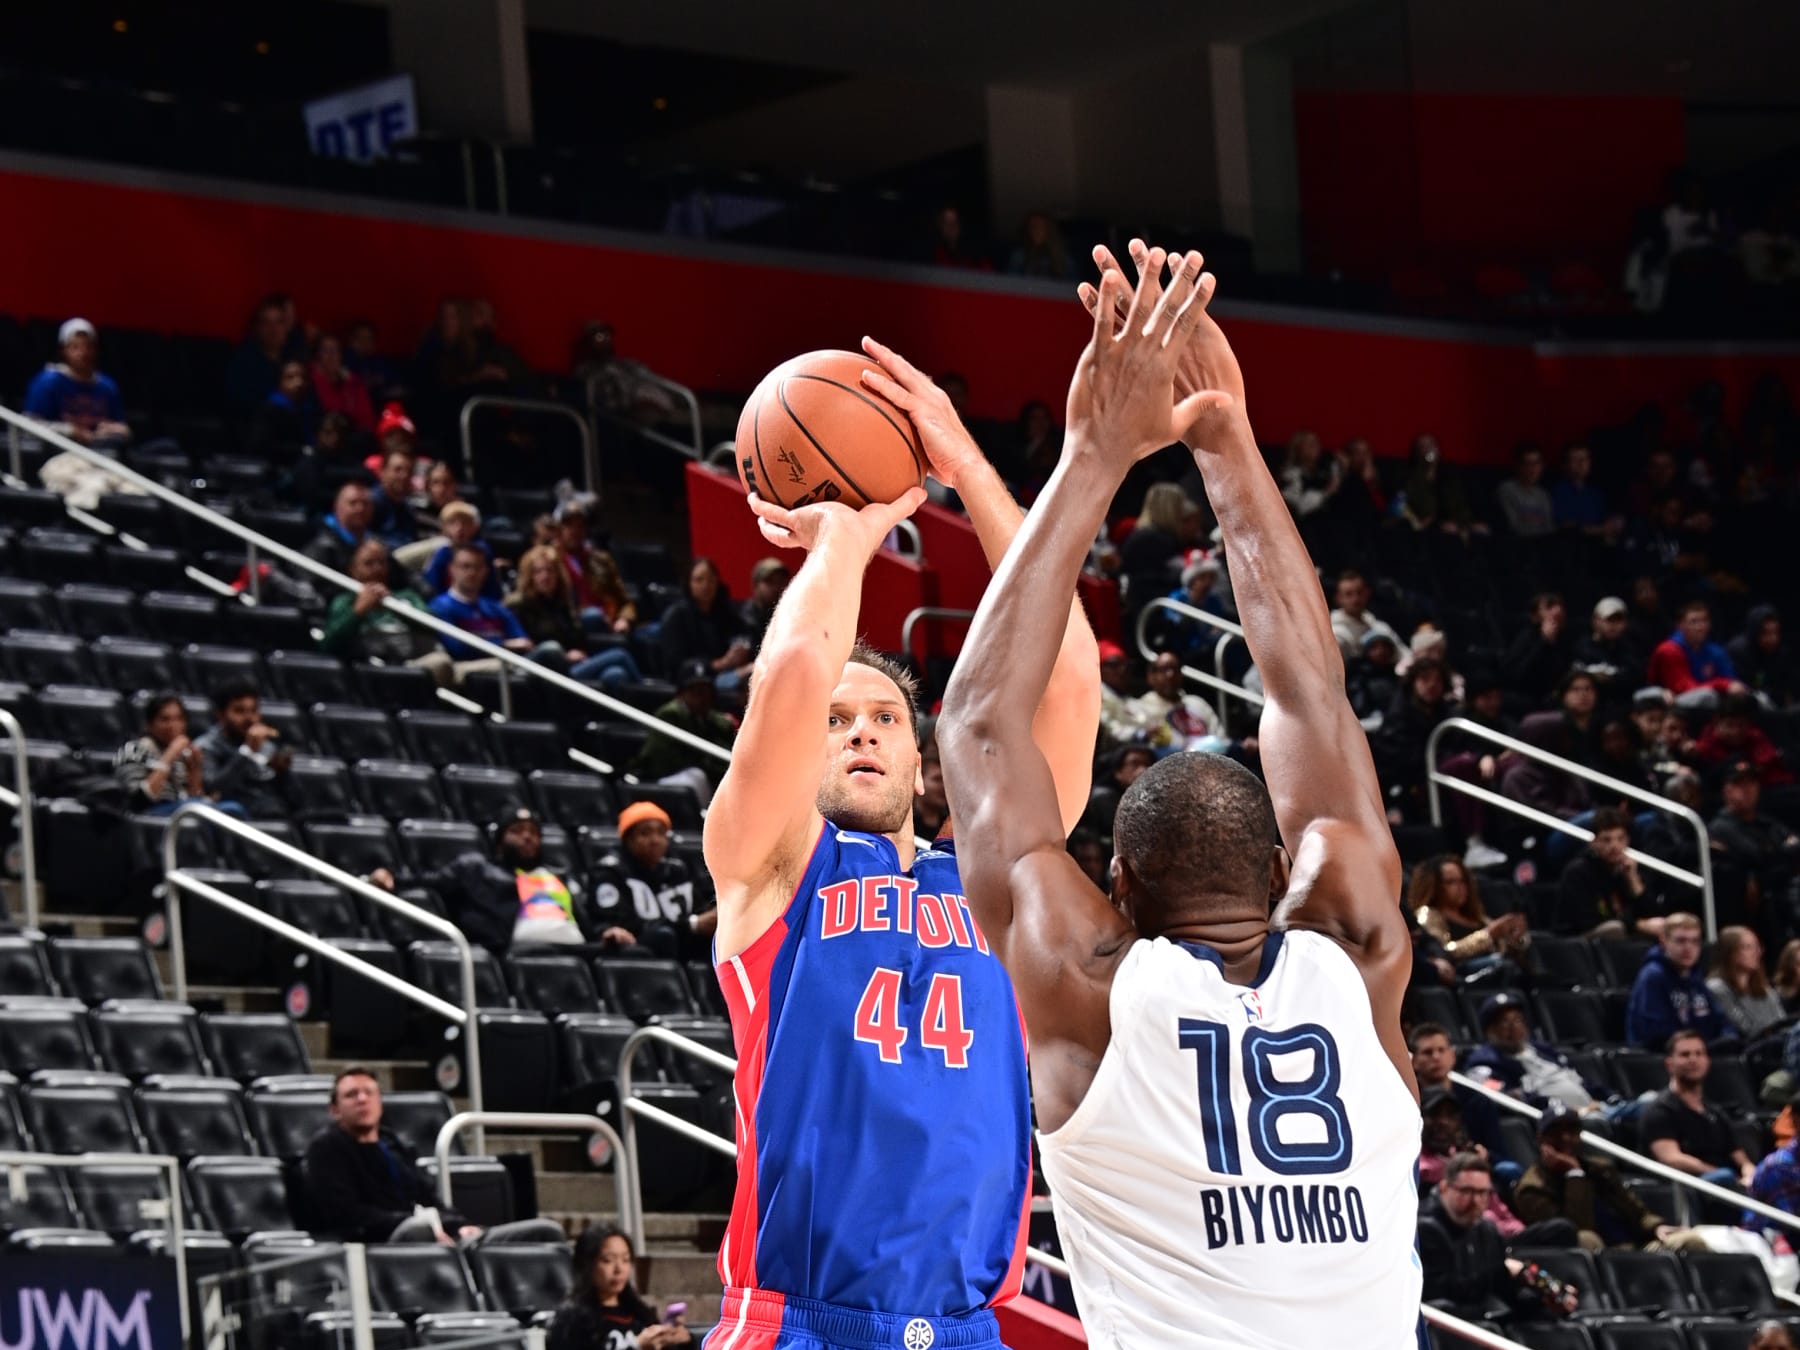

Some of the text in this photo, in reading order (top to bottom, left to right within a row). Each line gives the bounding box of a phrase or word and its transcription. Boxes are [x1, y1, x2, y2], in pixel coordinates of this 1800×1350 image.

[818, 875, 990, 956] DETOIT
[854, 967, 974, 1068] 44
[1178, 1016, 1353, 1176] 18
[1200, 1184, 1369, 1250] BIYOMBO
